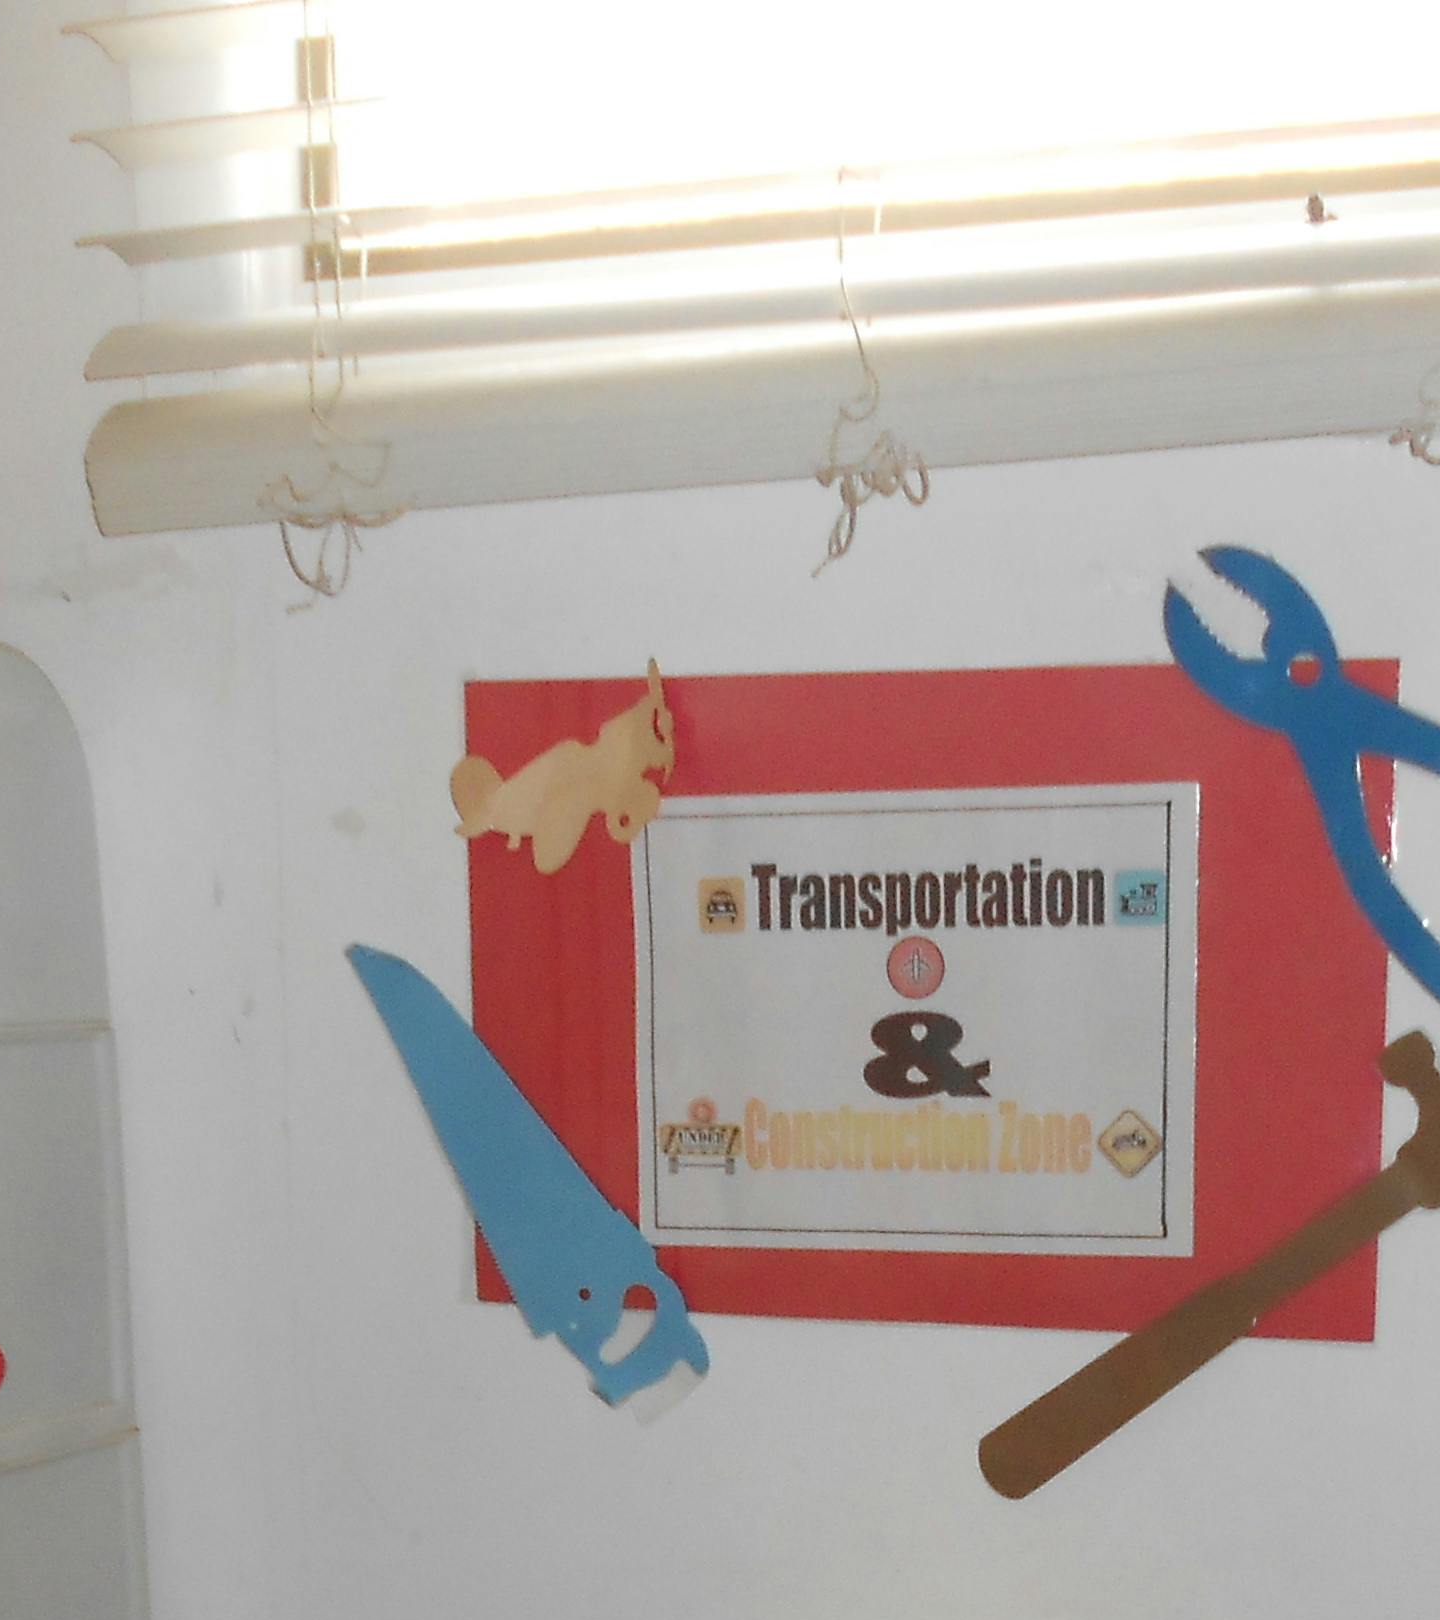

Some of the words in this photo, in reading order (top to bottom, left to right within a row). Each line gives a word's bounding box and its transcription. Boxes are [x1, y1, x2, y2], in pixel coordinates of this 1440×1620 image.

[751, 858, 1105, 936] Transportation
[863, 1011, 991, 1097] &
[744, 1097, 991, 1172] Construction
[998, 1100, 1093, 1173] Zone
